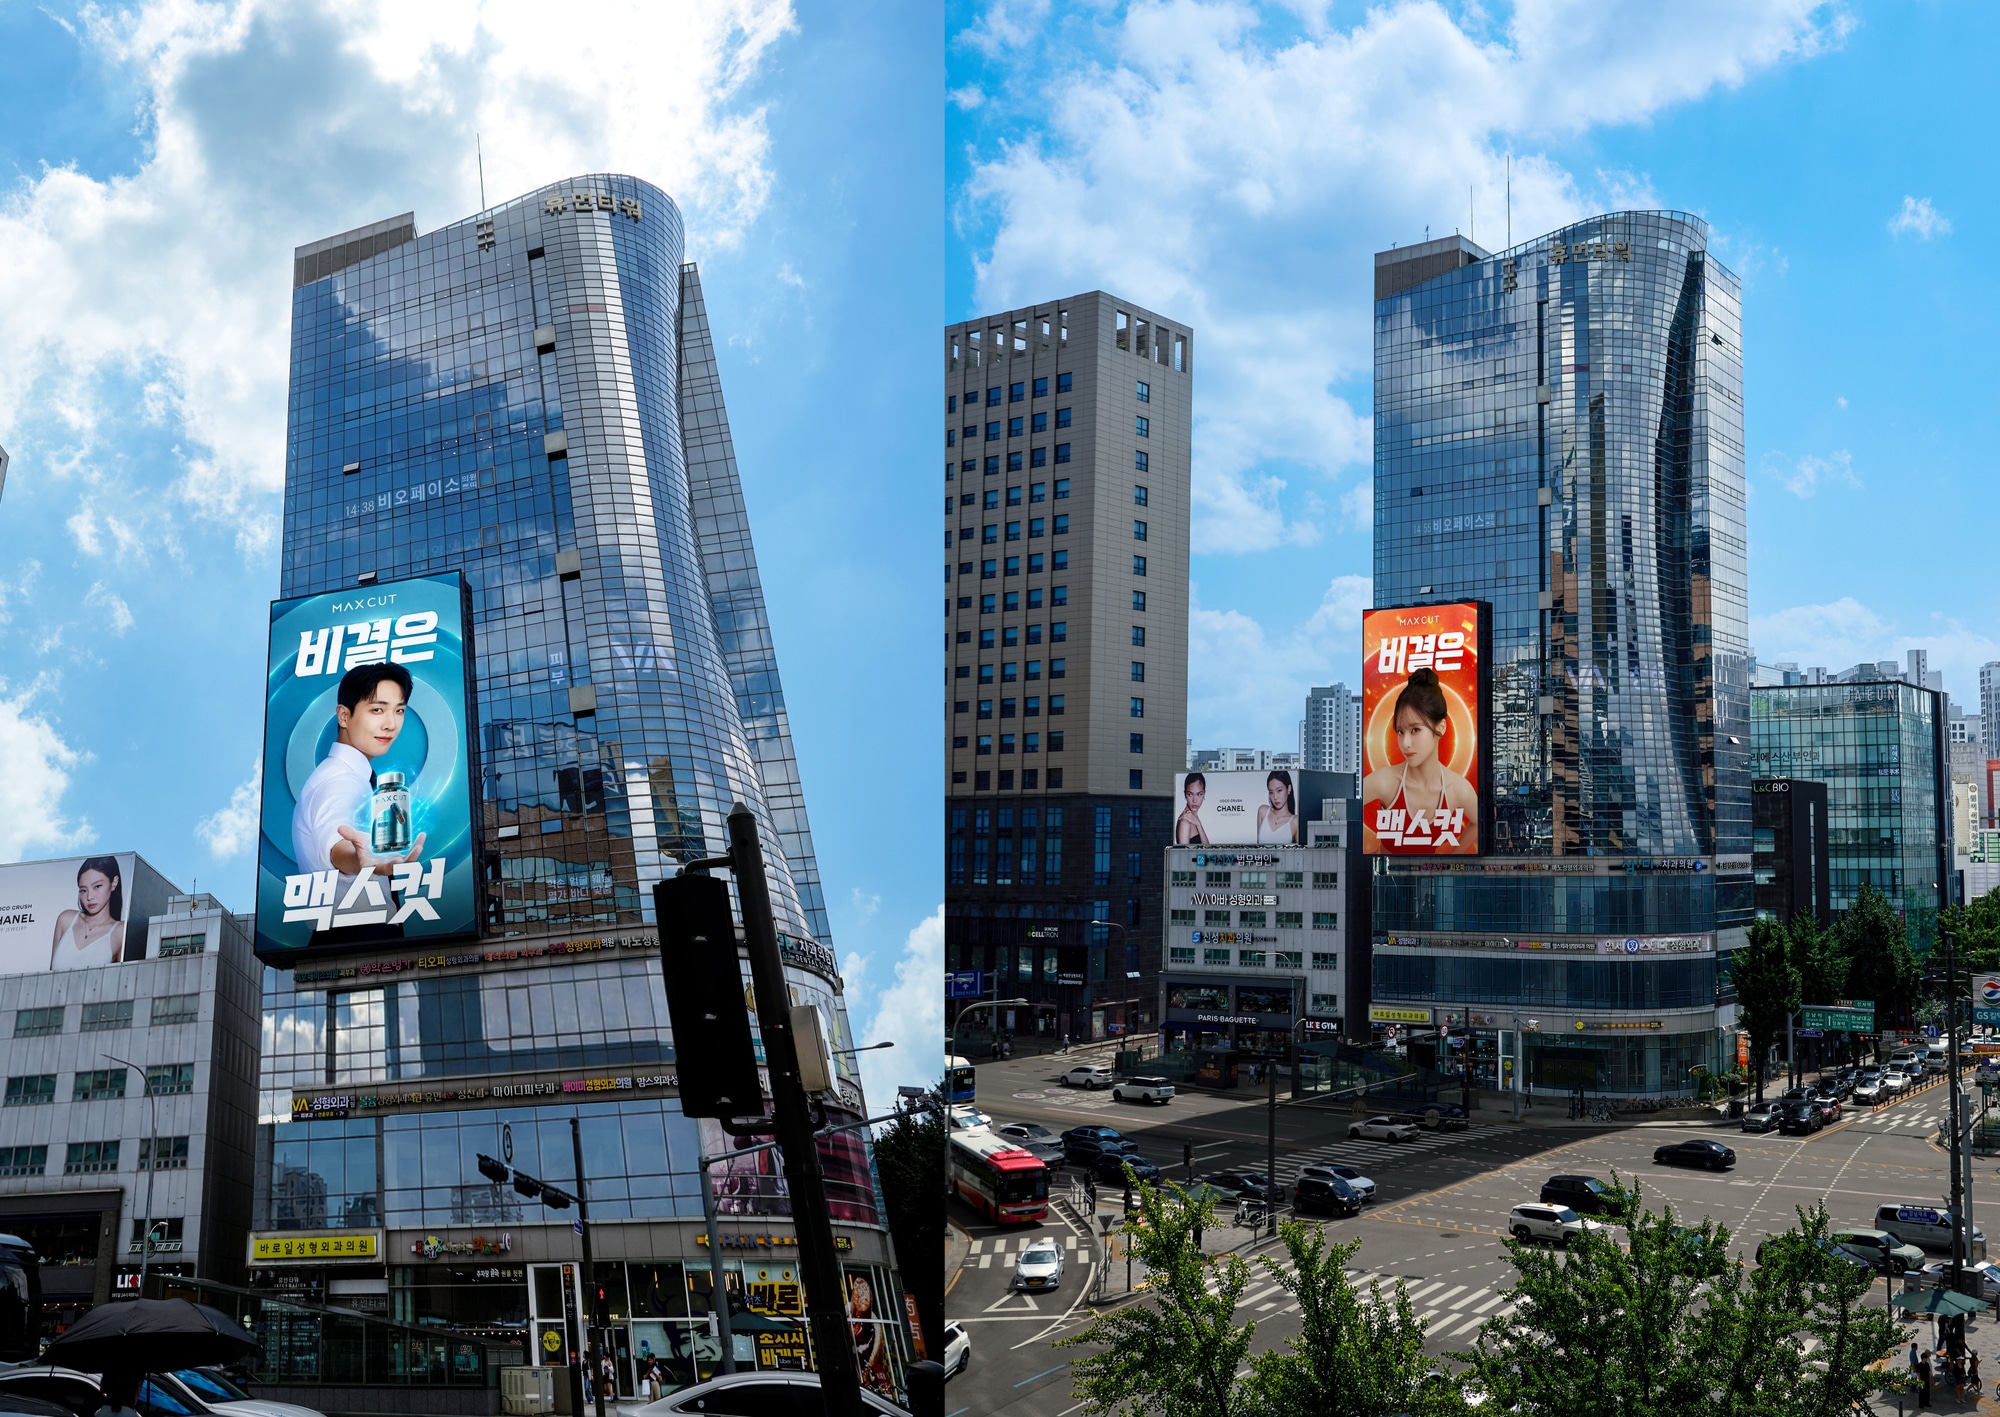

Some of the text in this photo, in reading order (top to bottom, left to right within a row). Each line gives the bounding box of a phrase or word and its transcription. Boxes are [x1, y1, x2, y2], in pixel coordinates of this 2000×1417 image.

[544, 191, 643, 223] 휴먼타워
[1551, 240, 1631, 265] 휴먼타워
[378, 478, 460, 509] 비오페이스
[1413, 523, 1431, 534] 1455
[1433, 515, 1484, 533] 비오페이스
[332, 594, 397, 613] MAXCUT
[1400, 615, 1440, 626] MAXCUT
[295, 610, 438, 678] 비결은
[1378, 631, 1465, 674] 비결은
[1846, 688, 1895, 703] JAEUN
[1753, 783, 1790, 793] L&C BIO
[1375, 807, 1464, 847] 맥스컷
[1236, 854, 1272, 867] 법무법인
[283, 857, 447, 931] 맥스컷
[1229, 893, 1263, 906] 성형외과
[1198, 1014, 1257, 1025] PARIS BAGUETTE
[1976, 1011, 1989, 1020] GS
[1321, 1022, 1338, 1031] GYM
[493, 1082, 555, 1098] 마이디피부과
[312, 1095, 350, 1110] 성형외과
[260, 1240, 368, 1254] 바로일성형외과의원
[722, 1233, 775, 1249] PAIK'S
